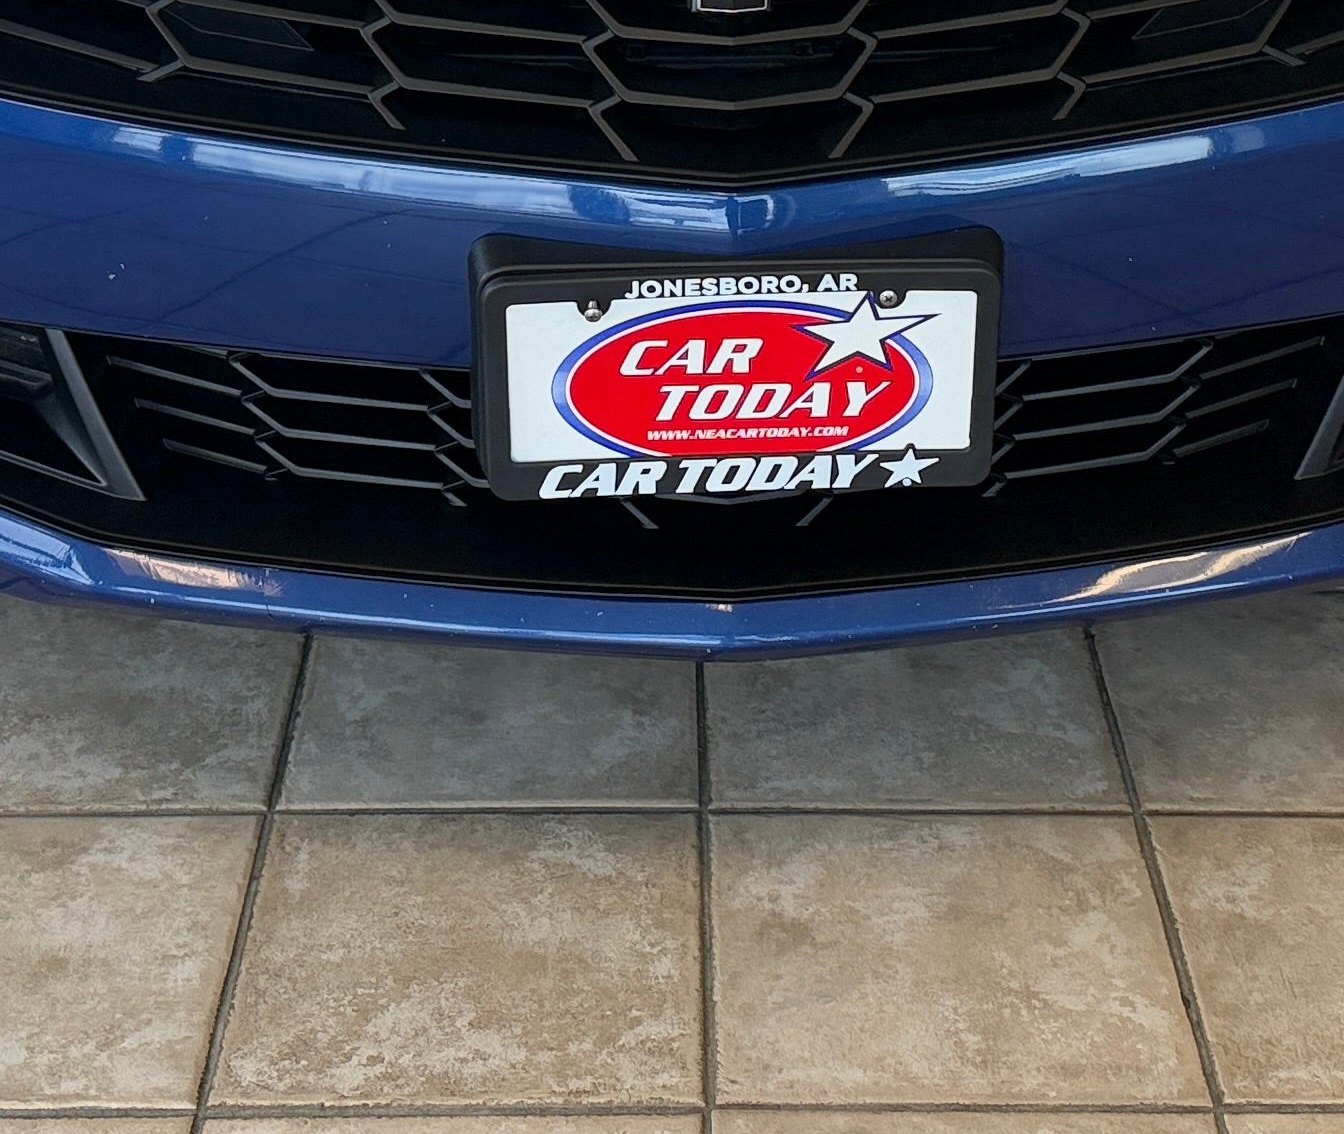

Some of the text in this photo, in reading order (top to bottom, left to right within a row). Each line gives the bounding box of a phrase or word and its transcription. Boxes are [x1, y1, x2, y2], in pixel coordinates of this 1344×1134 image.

[625, 273, 859, 299] JONESBORO, AR
[619, 338, 764, 376] CAR
[655, 380, 893, 422] TODAY
[647, 425, 849, 441] WWW.NEACARTODAY.COM
[538, 453, 881, 500] CAR TODAY
